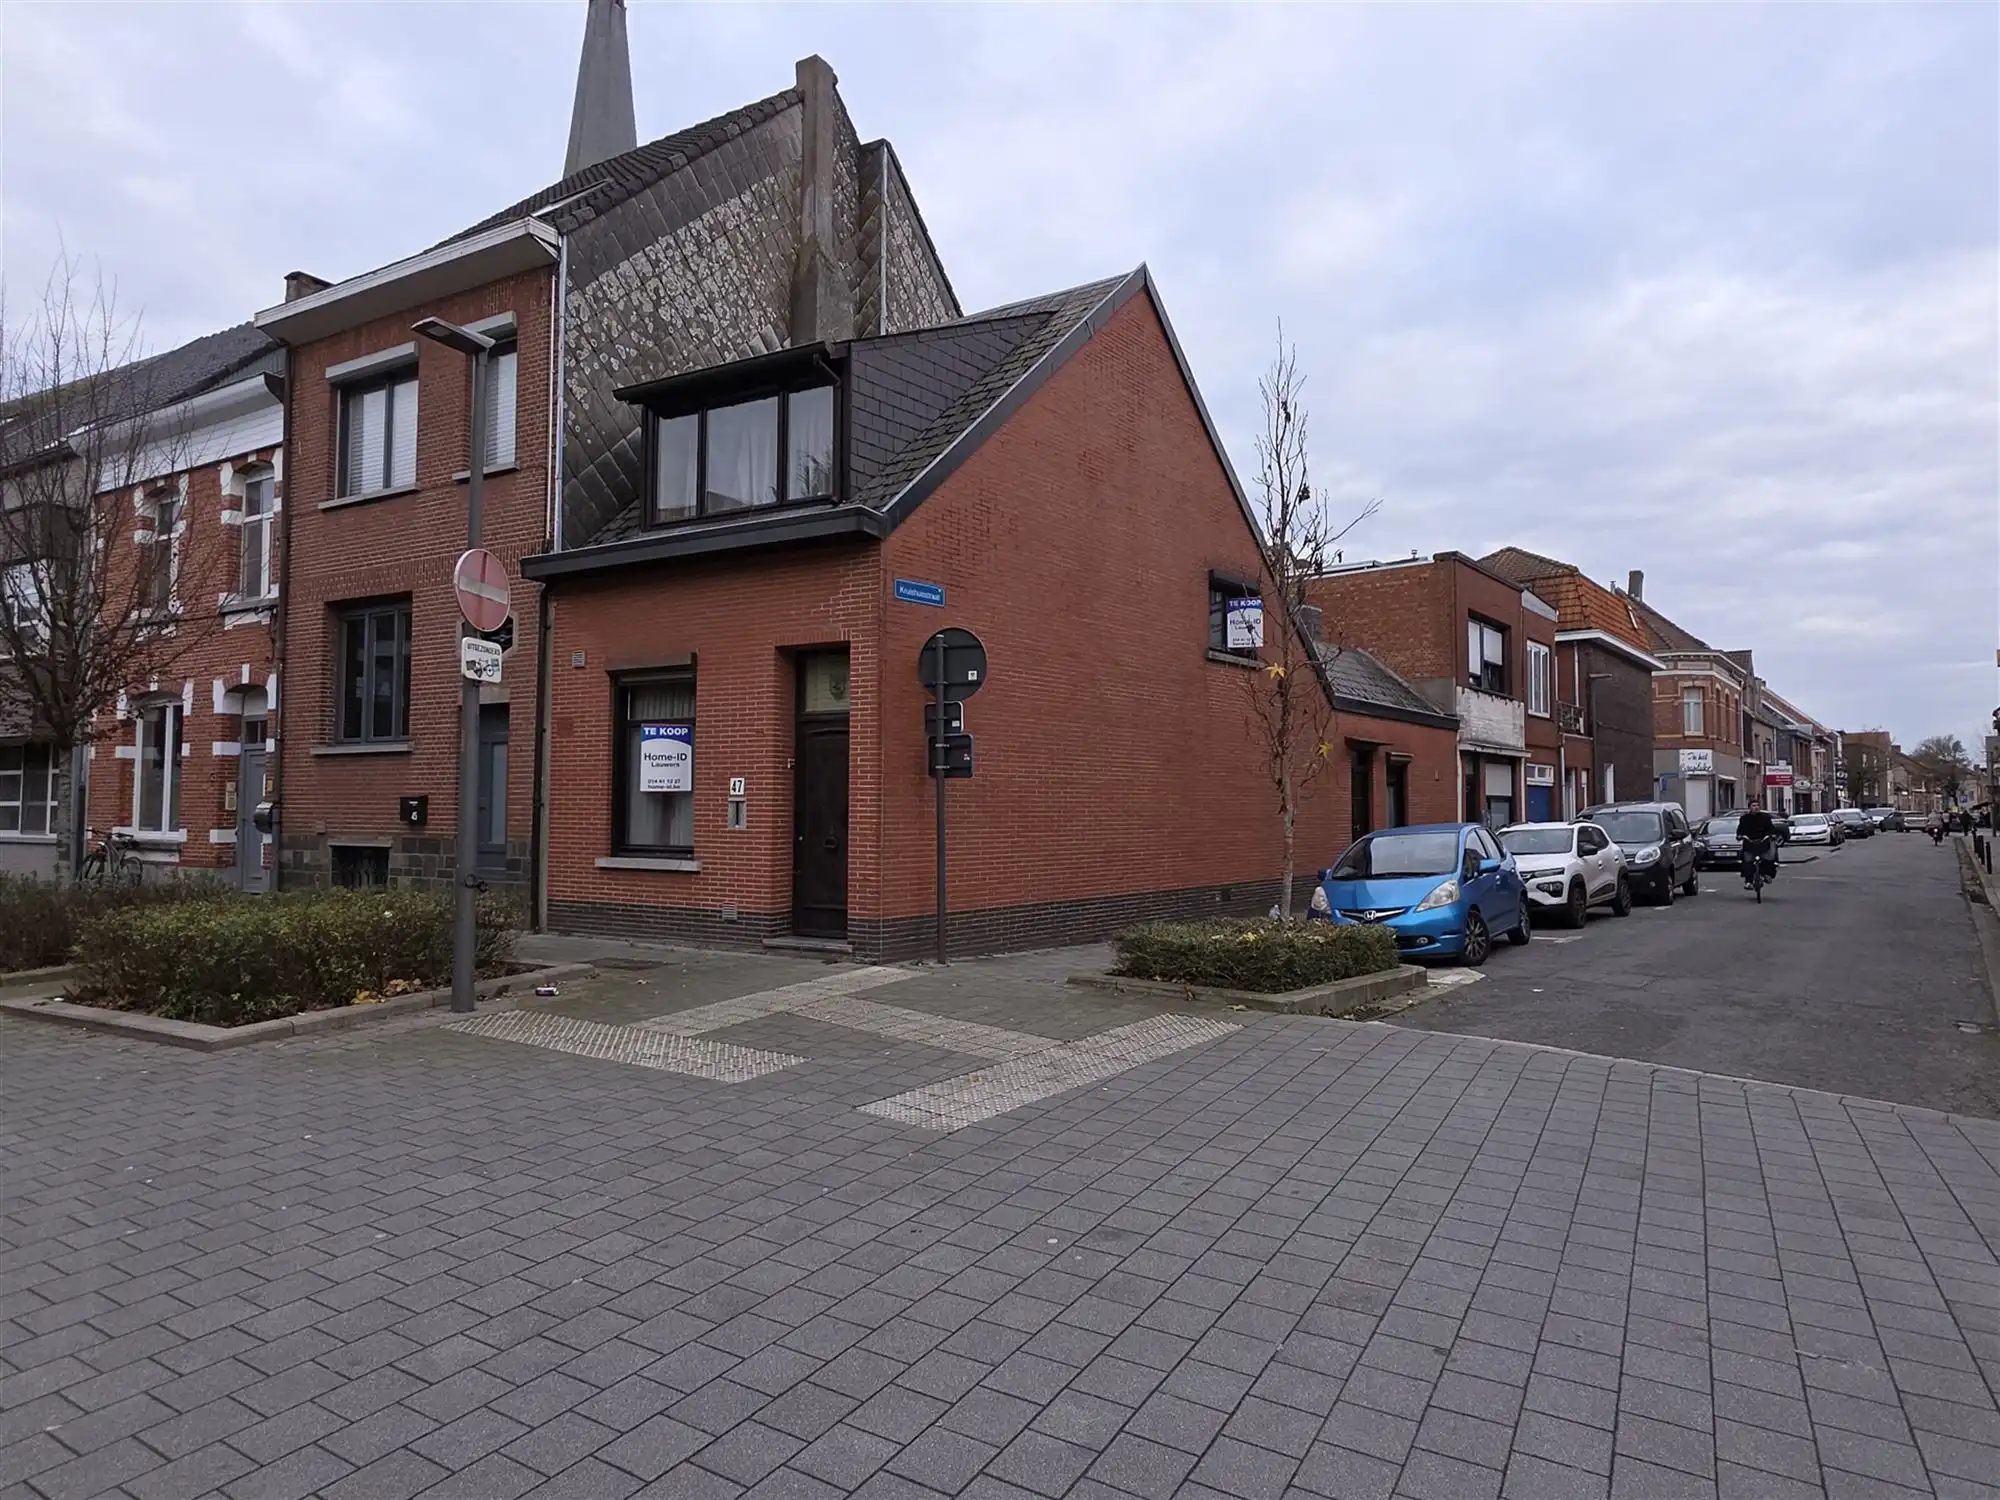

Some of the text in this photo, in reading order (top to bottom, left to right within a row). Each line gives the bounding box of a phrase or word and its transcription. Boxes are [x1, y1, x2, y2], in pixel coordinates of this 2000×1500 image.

[1240, 599, 1263, 607] KOOP
[644, 727, 688, 736] TE KOOP
[644, 752, 688, 761] Home-ID
[731, 779, 743, 793] 47
